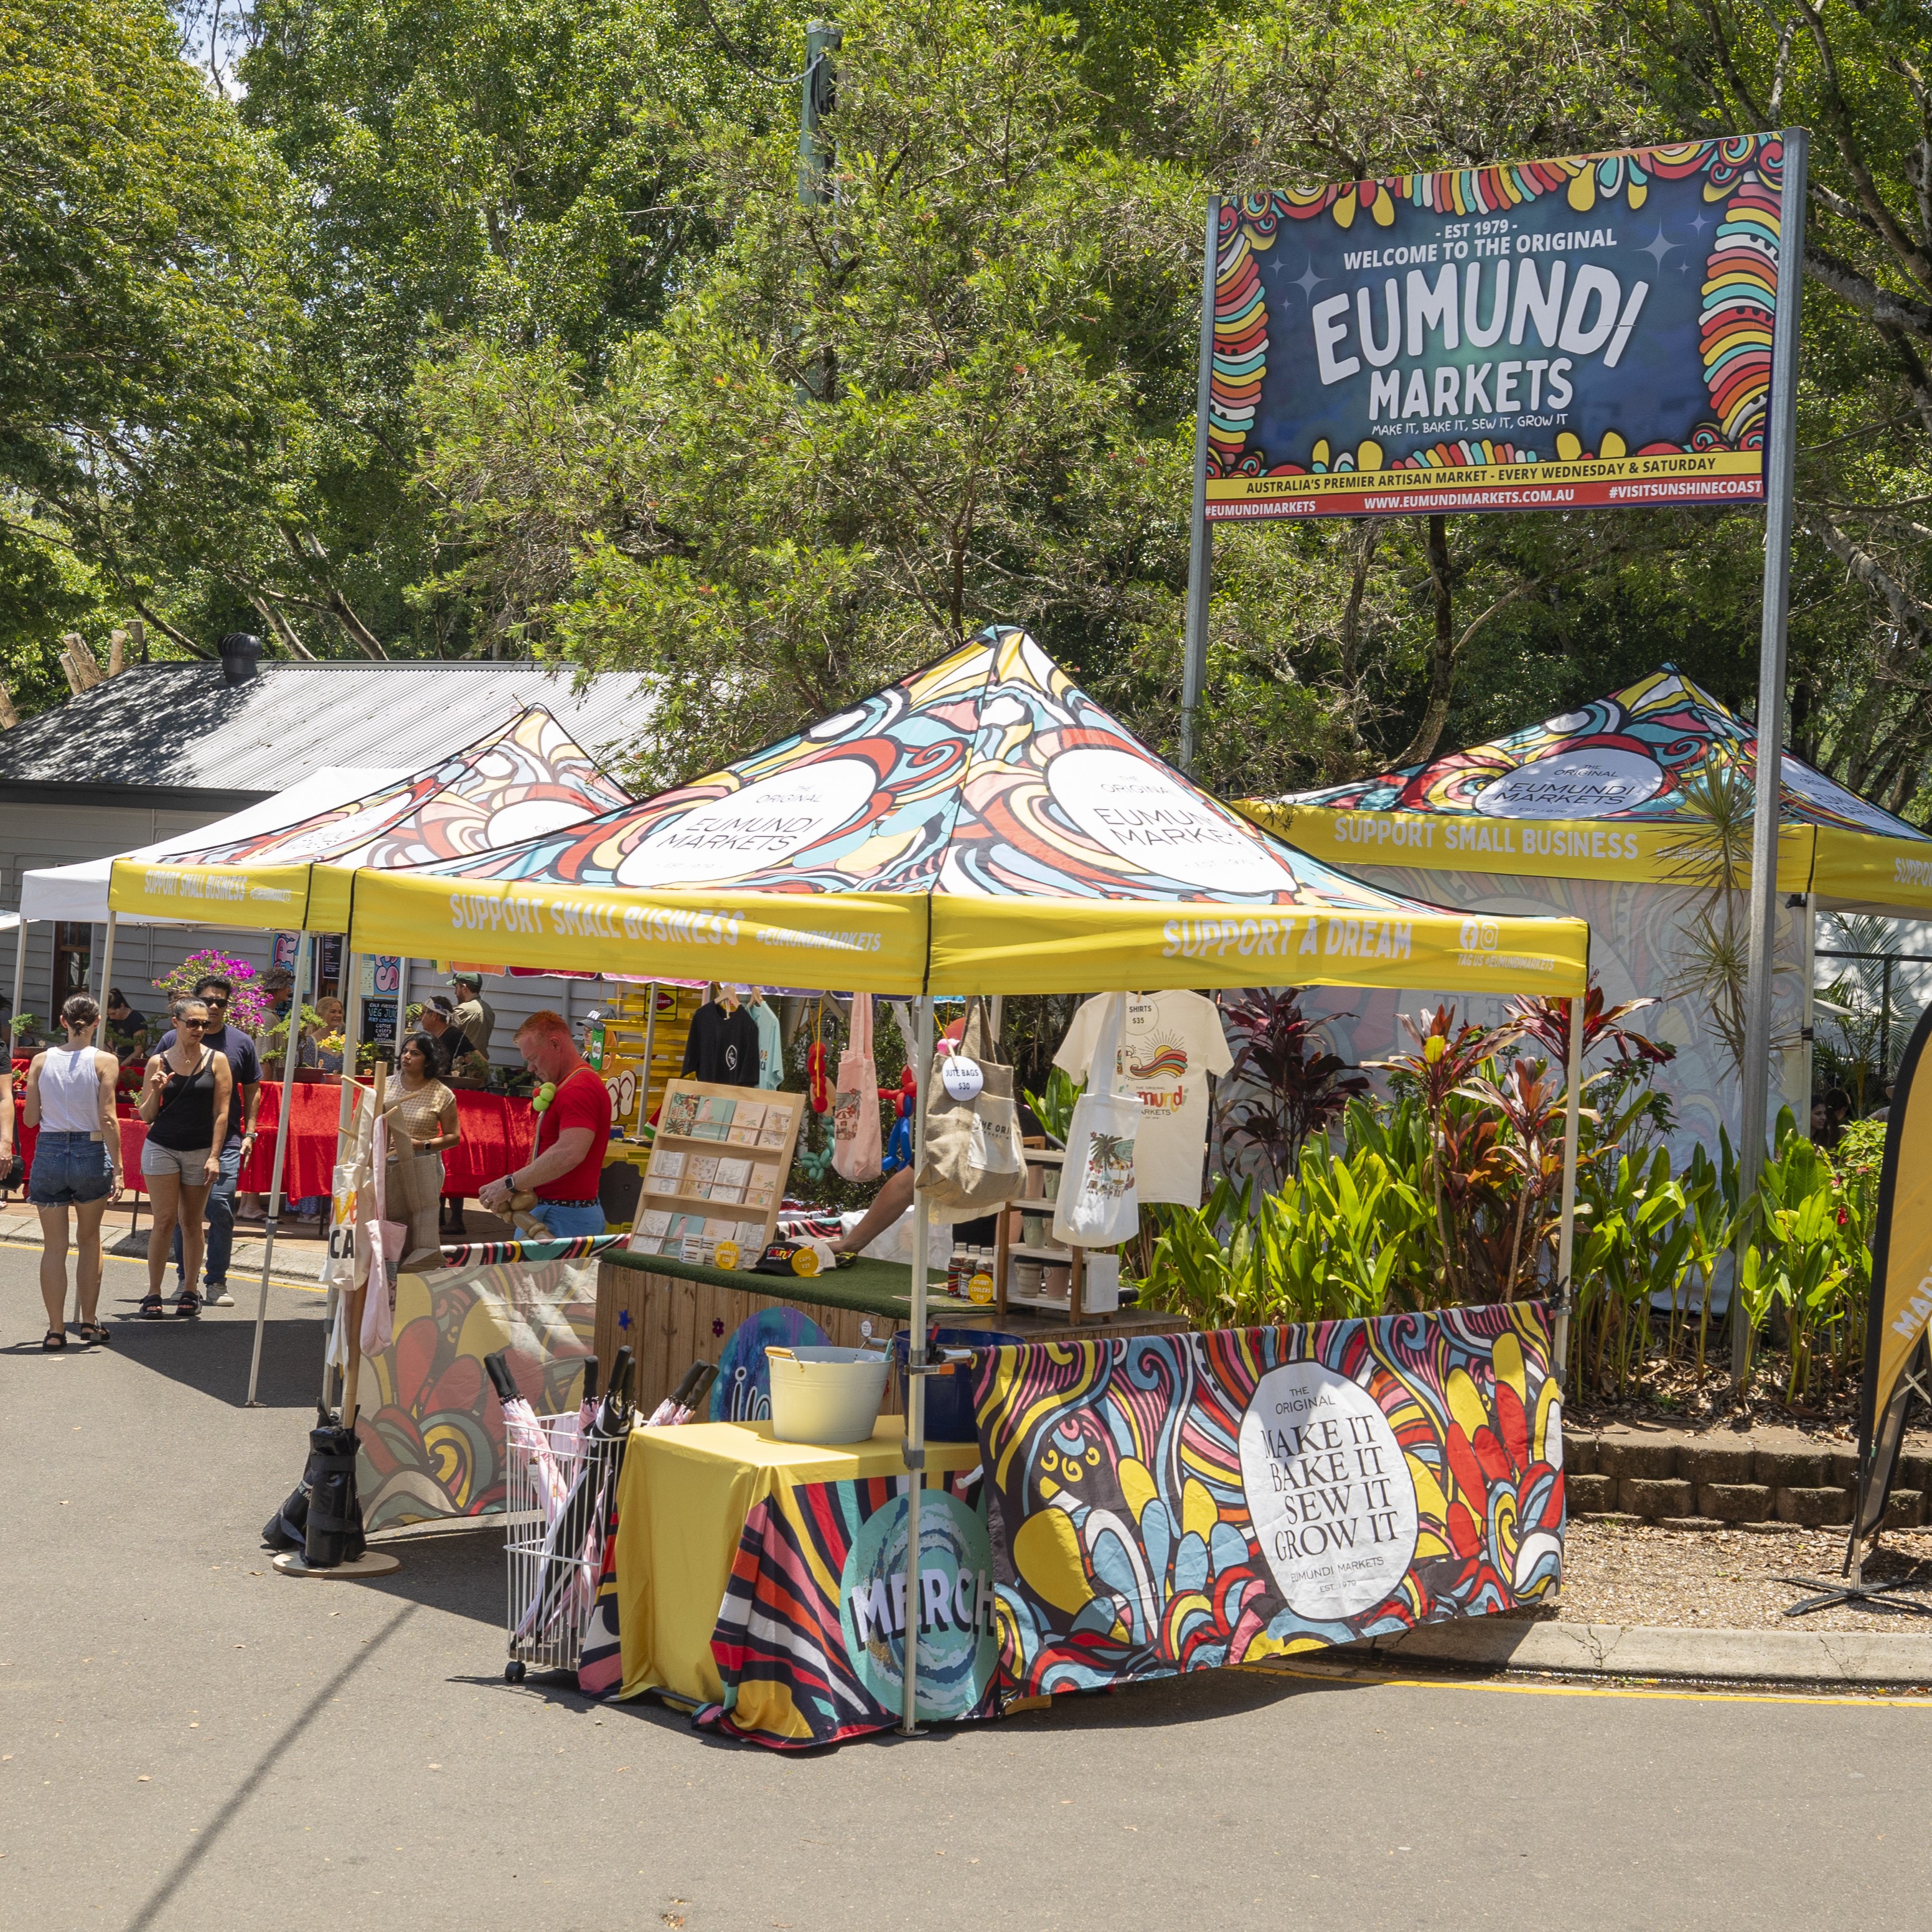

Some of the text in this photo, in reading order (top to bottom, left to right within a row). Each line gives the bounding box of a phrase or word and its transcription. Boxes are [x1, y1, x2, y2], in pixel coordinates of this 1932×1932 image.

[1445, 223, 1470, 239] EST
[1473, 219, 1509, 237] 1979
[1344, 228, 1617, 270] WELCOME TO THE ORIGINAL
[1312, 258, 1649, 385] EUMUNDI
[1369, 357, 1573, 420] MARKETS
[1372, 413, 1569, 436] MAKE IT, BAKE IT, SEW IT, GROW IT
[1324, 475, 1375, 489] PREMIER
[1378, 473, 1432, 487] ARTISAN
[1435, 470, 1488, 484] MARKET
[1498, 467, 1539, 481] EVERY
[1542, 463, 1625, 479] WEDNESDAY
[1629, 462, 1639, 474] &
[1643, 458, 1717, 473] SATURDAY
[1364, 489, 1575, 509] WWW.EUMUNDIMARKETS.COM.AU
[1609, 481, 1763, 499] #VISITSUNSHINECOAST
[1206, 501, 1316, 517] #EUMUNDIMARKETS
[1494, 792, 1627, 805] MARKETS
[1508, 782, 1636, 795] EUMUNDI
[756, 794, 822, 804] ORIGINAL
[693, 817, 823, 832] EUMUNDI
[657, 835, 799, 851] MARKETS
[1334, 817, 1436, 848] SUPPORT
[1445, 825, 1516, 853] SMALL
[1522, 829, 1638, 860] BUSINESS
[144, 870, 181, 896] SUPPORT
[180, 874, 205, 898] SMALL
[205, 875, 248, 901] BUSINESS
[449, 894, 881, 952] SUPPORT SMALL BUSINESS #EUMUNDIMARKETS
[1163, 918, 1412, 960] SUPPORT A DREAM
[1458, 954, 1555, 971] TAG US #EUMUNDIMARKETS
[368, 1008, 382, 1016] VEG
[1290, 1386, 1310, 1397] THE
[1275, 1395, 1336, 1415] ORIGINAL
[1260, 1415, 1377, 1459] MAKE IT
[1270, 1446, 1386, 1493] BAKE IT
[1285, 1478, 1393, 1525] SEW IT
[1275, 1511, 1399, 1561] GROW IT
[1338, 1557, 1384, 1573] MARKETS
[1320, 1579, 1357, 1593] EST 1979
